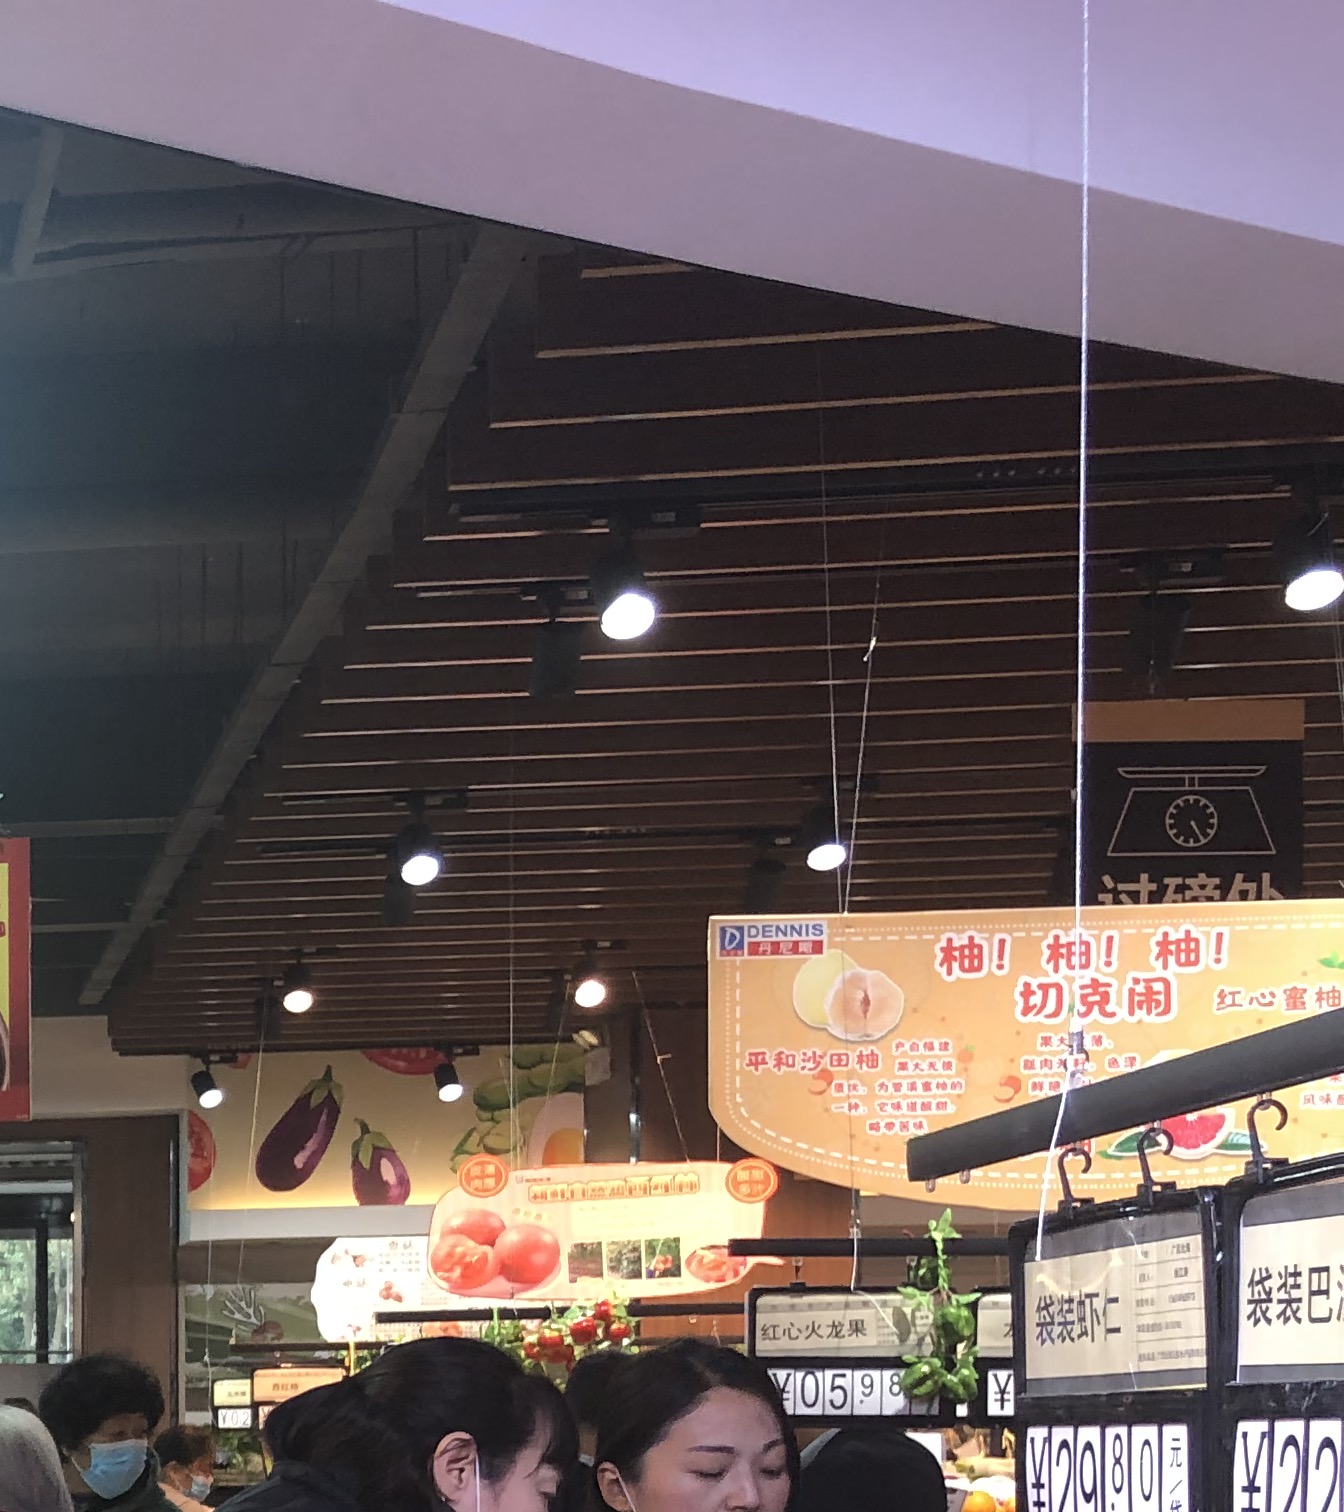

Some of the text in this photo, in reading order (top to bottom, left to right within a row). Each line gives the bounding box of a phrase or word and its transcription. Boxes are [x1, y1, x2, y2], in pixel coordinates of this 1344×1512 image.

[747, 923, 824, 938] DENNIS
[1019, 977, 1172, 1018] 切克闹
[1217, 986, 1342, 1011] 红心蜜柚
[745, 1049, 879, 1073] 平和沙田柚
[1247, 1264, 1344, 1327] 袋装巴
[761, 1319, 867, 1341] 红心火龙果
[1035, 1289, 1121, 1347] 袋装虾仁
